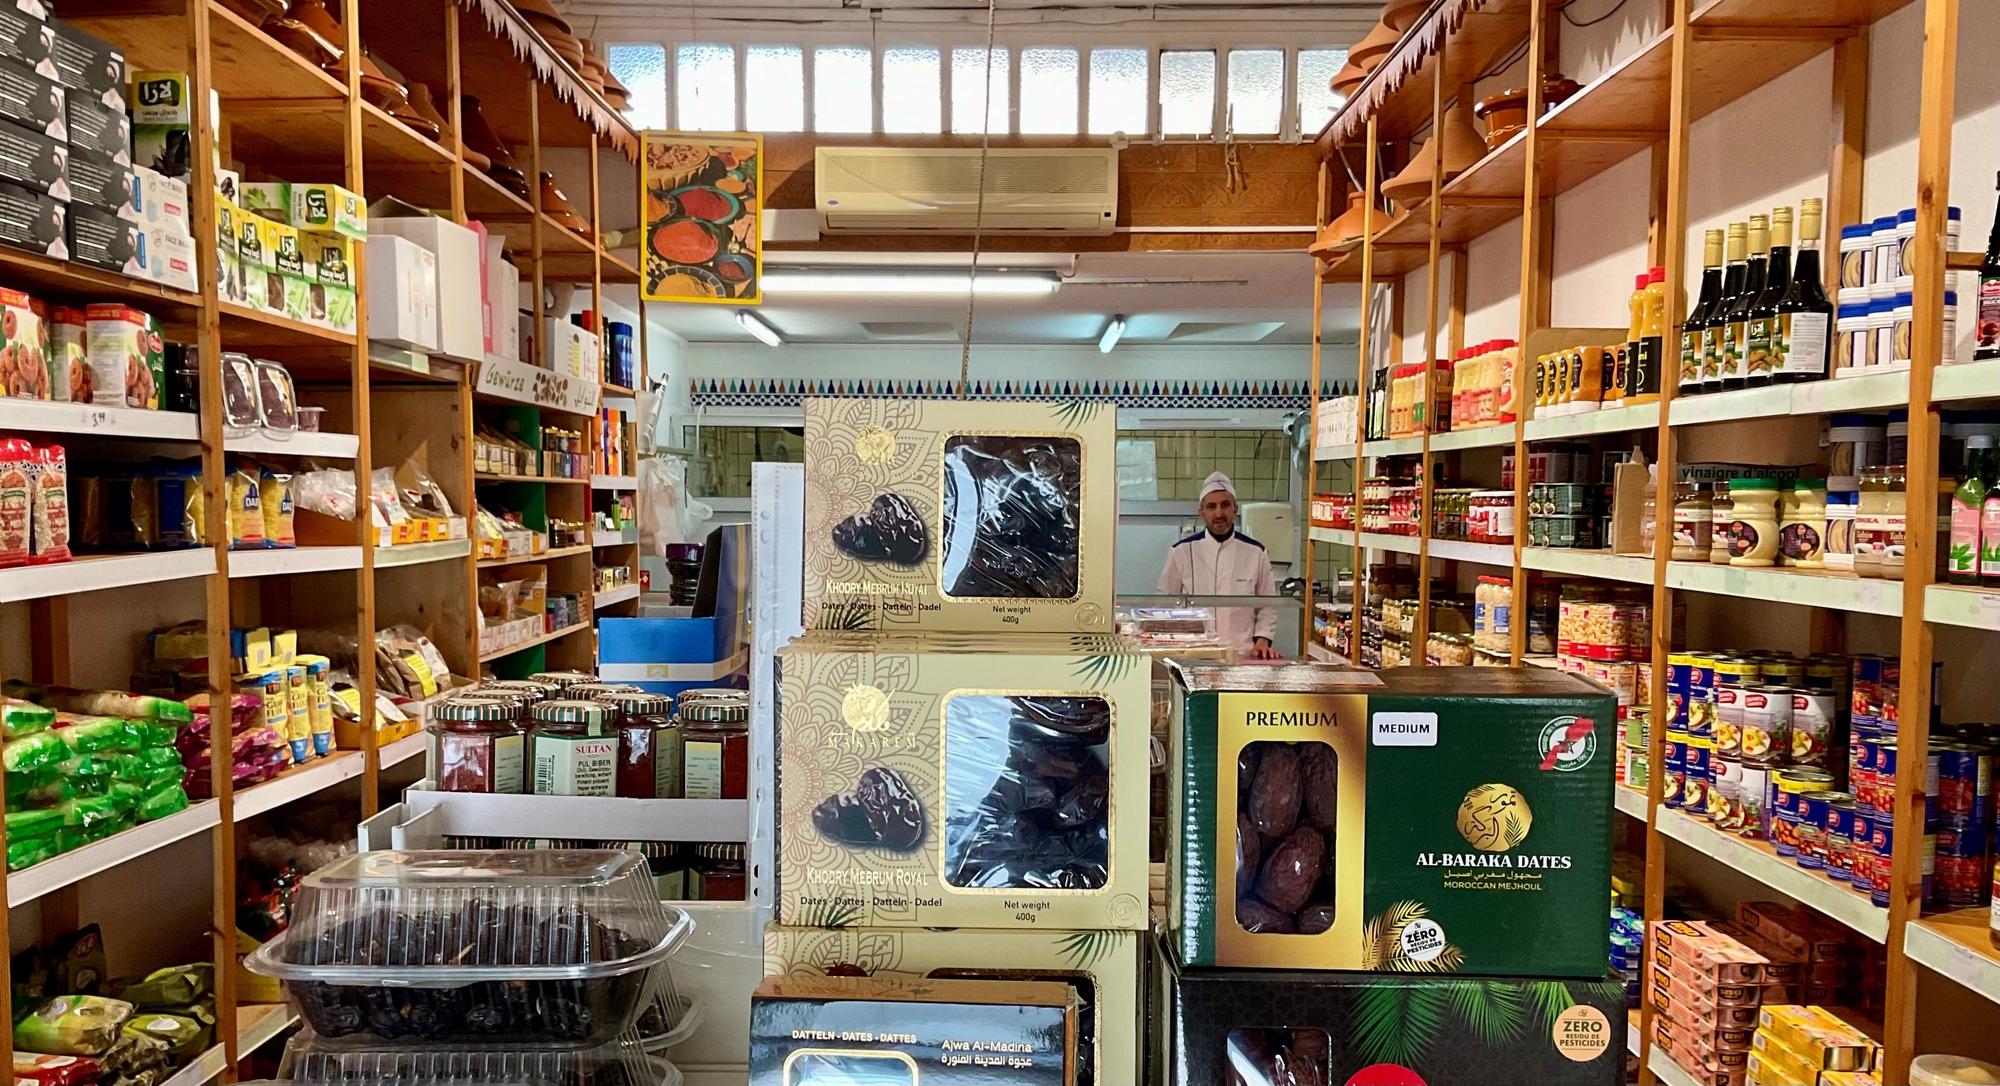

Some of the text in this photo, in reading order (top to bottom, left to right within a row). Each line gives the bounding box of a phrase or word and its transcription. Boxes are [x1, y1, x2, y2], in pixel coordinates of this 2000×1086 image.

[485, 363, 525, 392] Gewürze
[1682, 467, 1800, 480] vinaigre d'alcool
[826, 580, 860, 594] KHODRY
[822, 602, 845, 610] Dates
[850, 602, 876, 611] Dattes
[883, 602, 912, 611] Datteln
[918, 603, 942, 611] Dadel
[1007, 606, 1031, 614] weight
[1002, 616, 1019, 624] 400g
[1246, 711, 1338, 727] PREMIUM
[1378, 724, 1430, 733] MEDIUM
[827, 736, 916, 748] MAKAREM
[575, 745, 612, 754] SULTAN
[1416, 853, 1572, 869] AL-BARAKA DATES
[806, 868, 928, 886] KHODRY MEBRUM ROYAL
[1444, 882, 1542, 891] MOROCCAN MEJHOUL
[800, 896, 827, 906] Dates
[835, 897, 865, 906] Dattes
[873, 897, 907, 906] Datteln
[915, 898, 942, 907] Dadel
[1004, 901, 1050, 911] Net weight
[1016, 913, 1036, 923] 400g
[1405, 928, 1437, 944] ZÉRO
[1407, 941, 1443, 954] PESTICIDES
[1563, 1021, 1602, 1032] ZERO
[792, 1030, 835, 1040] DATTELN
[842, 1032, 873, 1042] DATES
[880, 1033, 918, 1044] DATTES
[942, 1040, 1032, 1052] Ajwa Al-Madina
[941, 1053, 1032, 1068] عجوة المدينة المنورة
